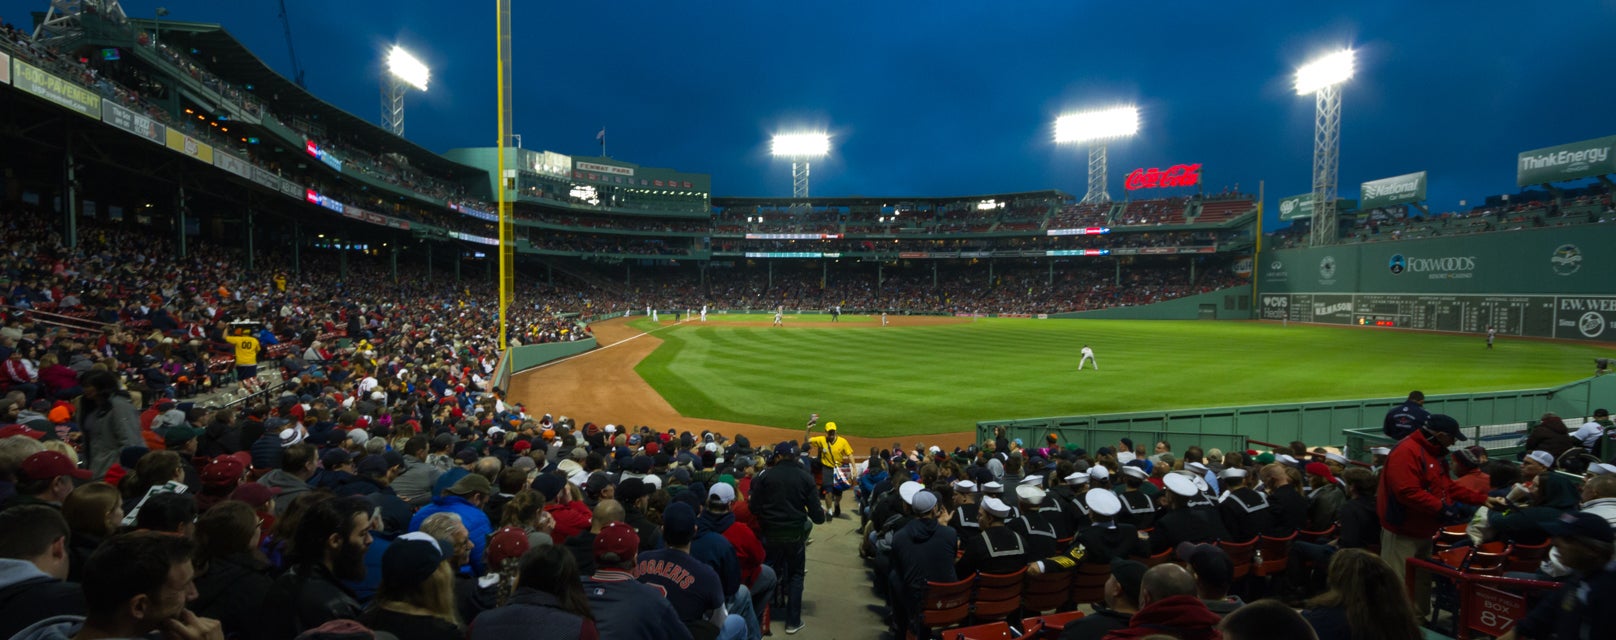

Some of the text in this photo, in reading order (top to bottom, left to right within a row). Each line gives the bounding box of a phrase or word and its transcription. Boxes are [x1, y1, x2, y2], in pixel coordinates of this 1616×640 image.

[15, 62, 99, 109] 1-800-PAVEMENT
[1521, 146, 1609, 170] ThinkEnergy
[579, 163, 631, 175] FENWAY PARK
[1376, 178, 1419, 197] National
[1407, 256, 1475, 272] FOXWOODS
[1271, 296, 1288, 307] CVS
[242, 341, 252, 349] 00
[1484, 600, 1510, 614] BOX
[1480, 610, 1514, 630] 87
